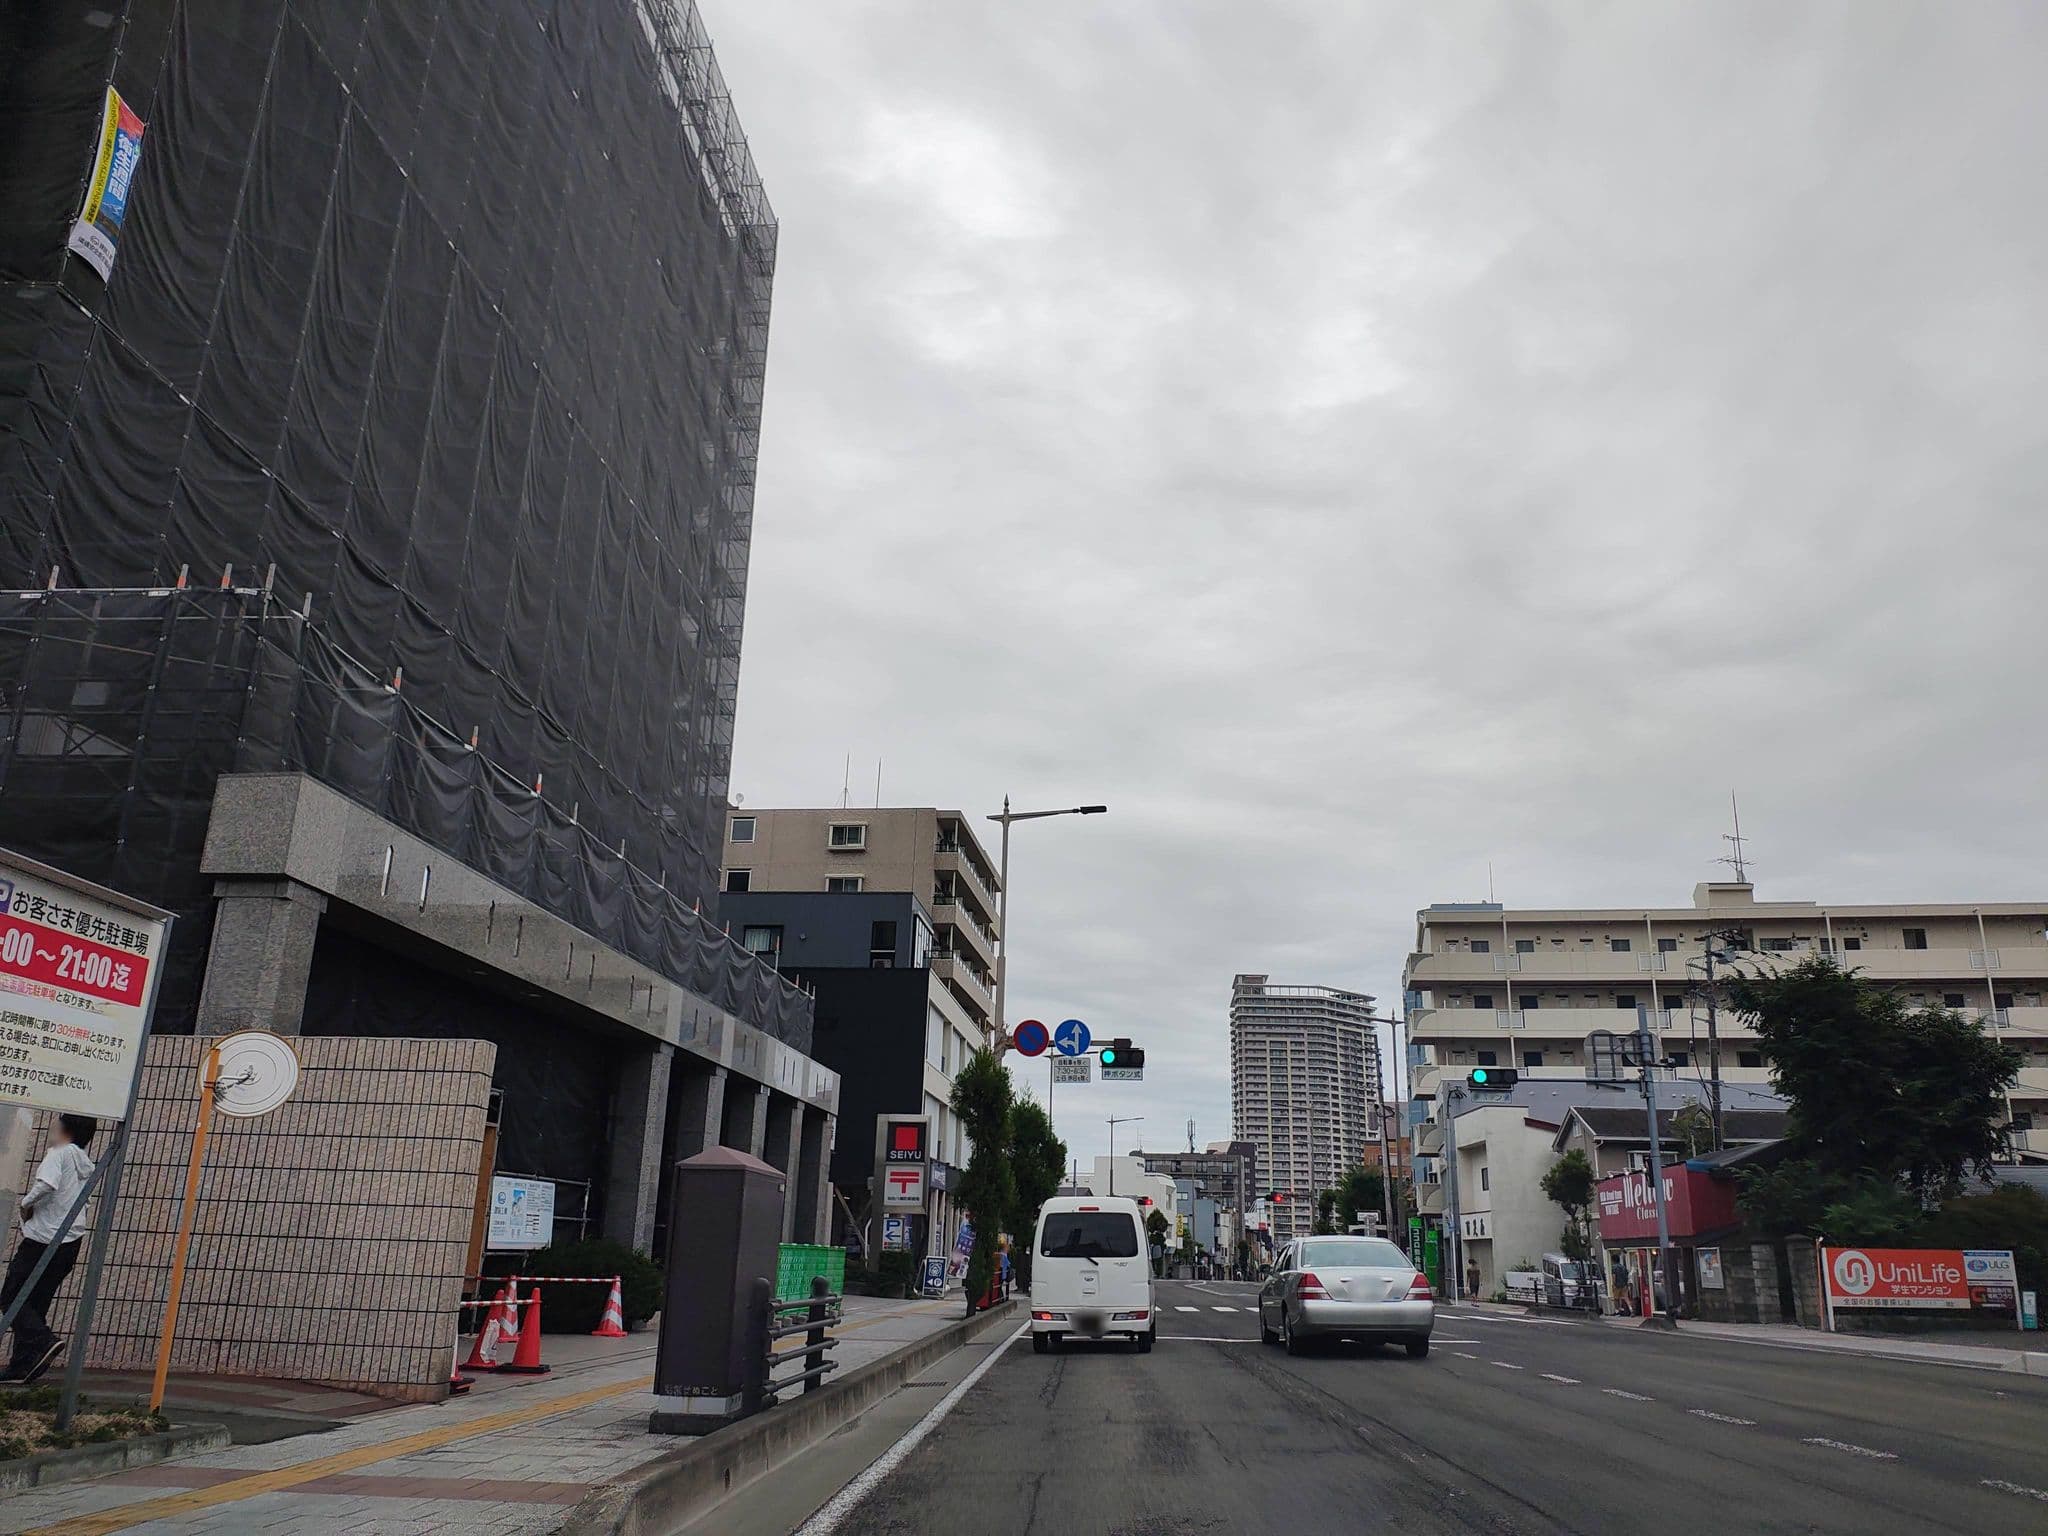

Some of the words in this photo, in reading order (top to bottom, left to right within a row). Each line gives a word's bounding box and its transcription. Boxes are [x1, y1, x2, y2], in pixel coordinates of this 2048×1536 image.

[13, 890, 150, 956] お客さま優先駐車場
[890, 1150, 922, 1160] SEIYU
[887, 1220, 901, 1231] P
[1988, 1259, 2010, 1269] ULG
[1878, 1263, 1961, 1284] UniLife
[1891, 1285, 1951, 1295] 学生マンション
